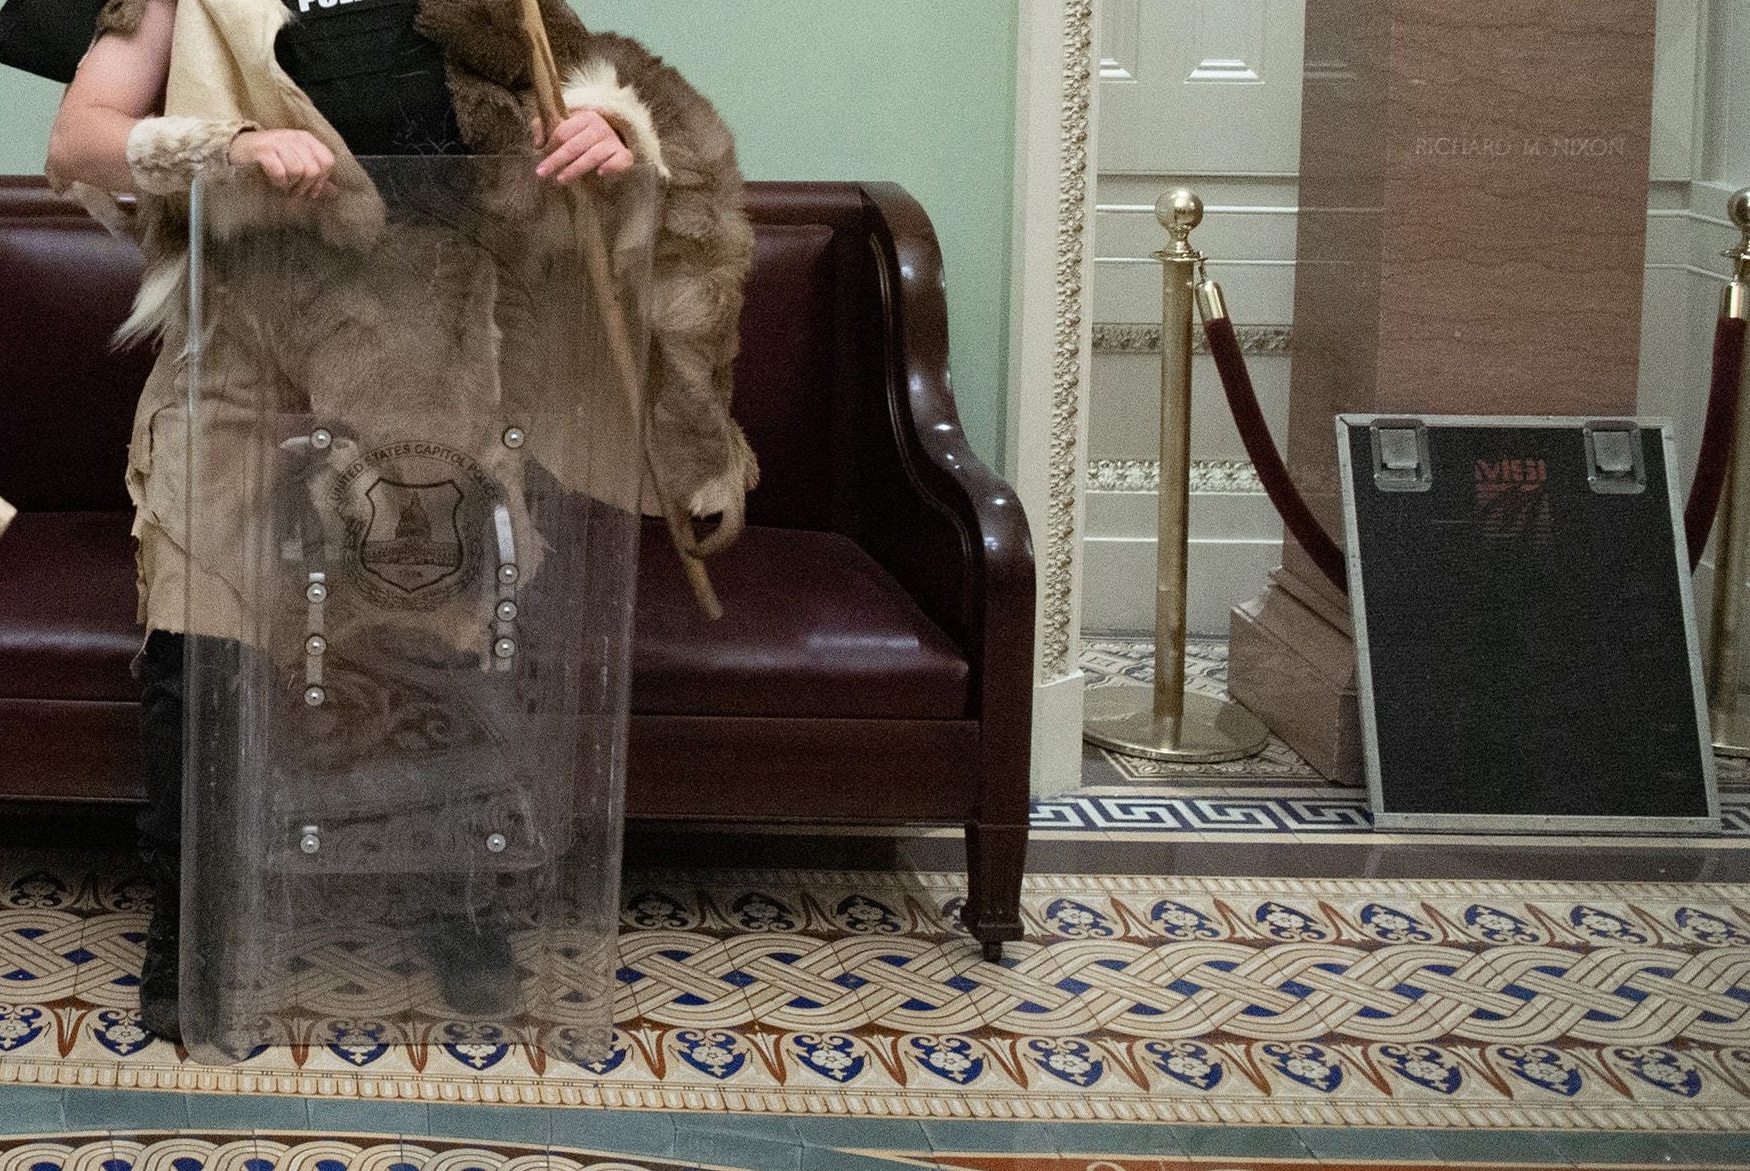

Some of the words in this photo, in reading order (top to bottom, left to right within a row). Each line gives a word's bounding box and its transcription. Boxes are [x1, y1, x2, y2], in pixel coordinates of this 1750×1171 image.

[1415, 136, 1512, 155] RICHARD
[1551, 136, 1627, 157] NIXON
[329, 462, 364, 502] UNITED
[364, 443, 411, 464] STATES
[414, 444, 465, 468] CAPITOL
[466, 461, 500, 501] POLICE
